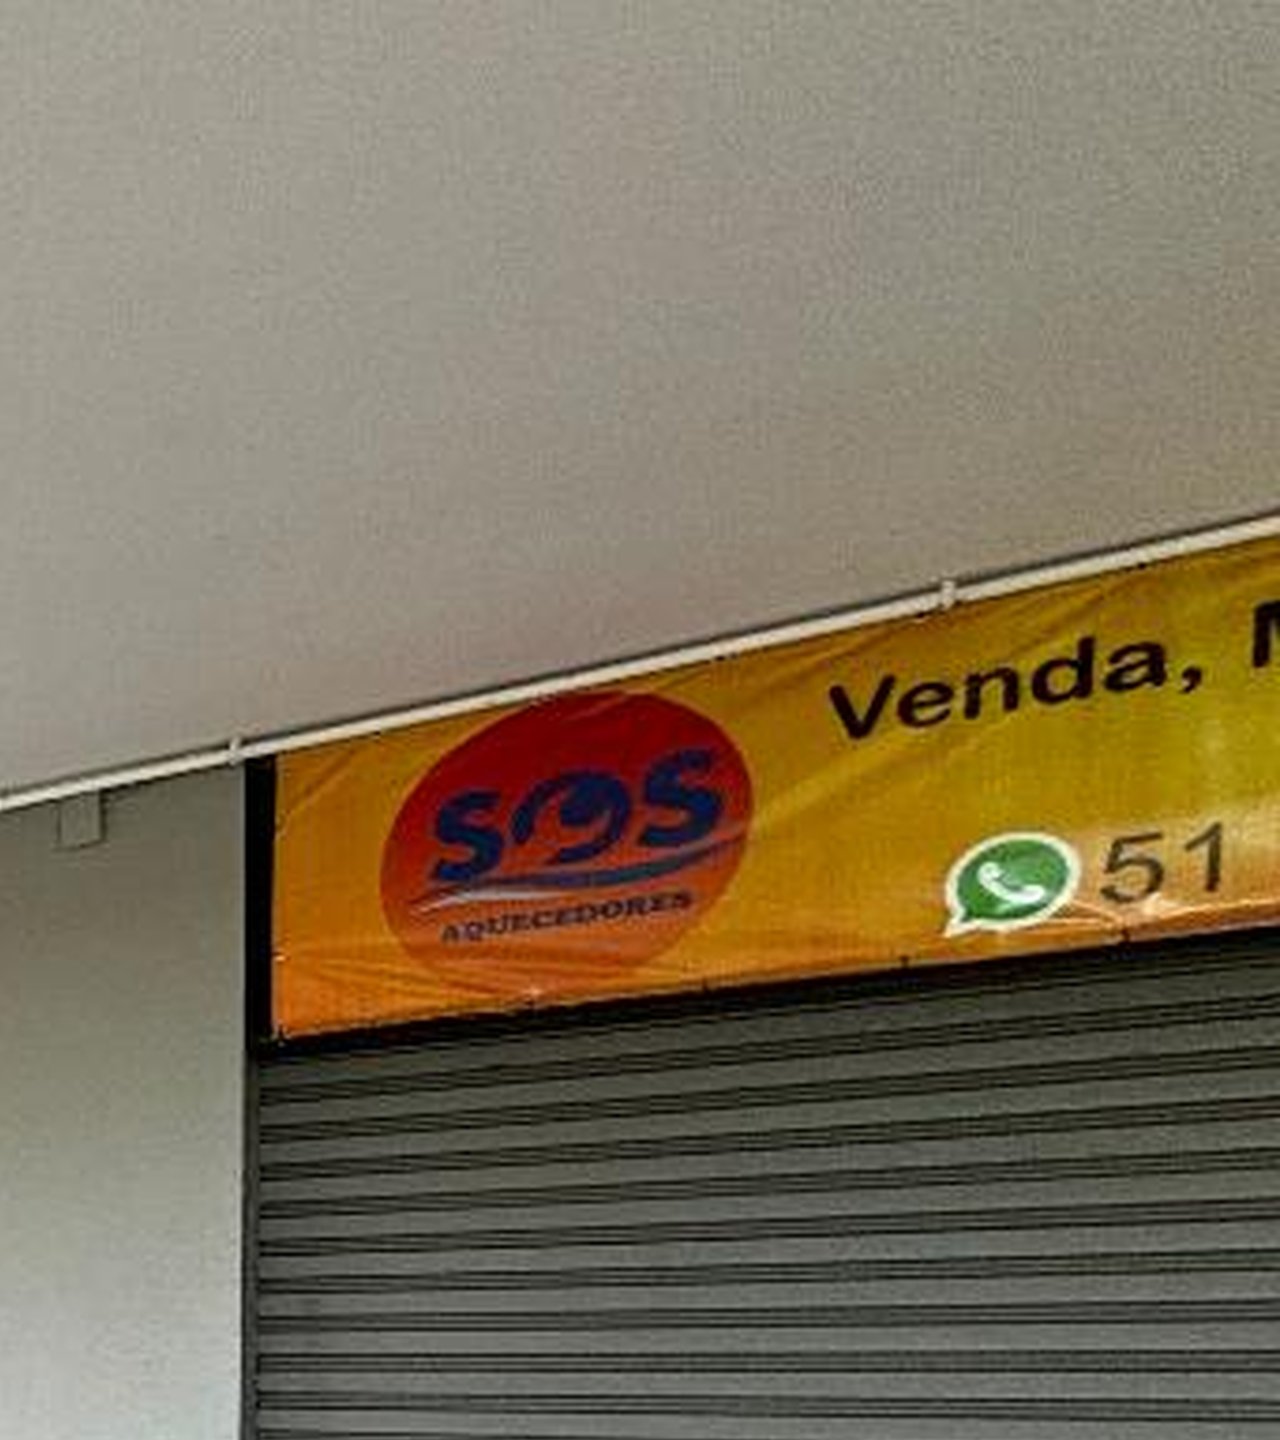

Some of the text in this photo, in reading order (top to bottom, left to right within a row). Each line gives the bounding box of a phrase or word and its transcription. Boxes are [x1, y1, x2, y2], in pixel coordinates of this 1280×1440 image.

[829, 636, 1203, 740] Venda,
[430, 748, 723, 882] SOS
[1100, 822, 1224, 902] 51
[442, 889, 694, 943] AQUECEDORES
